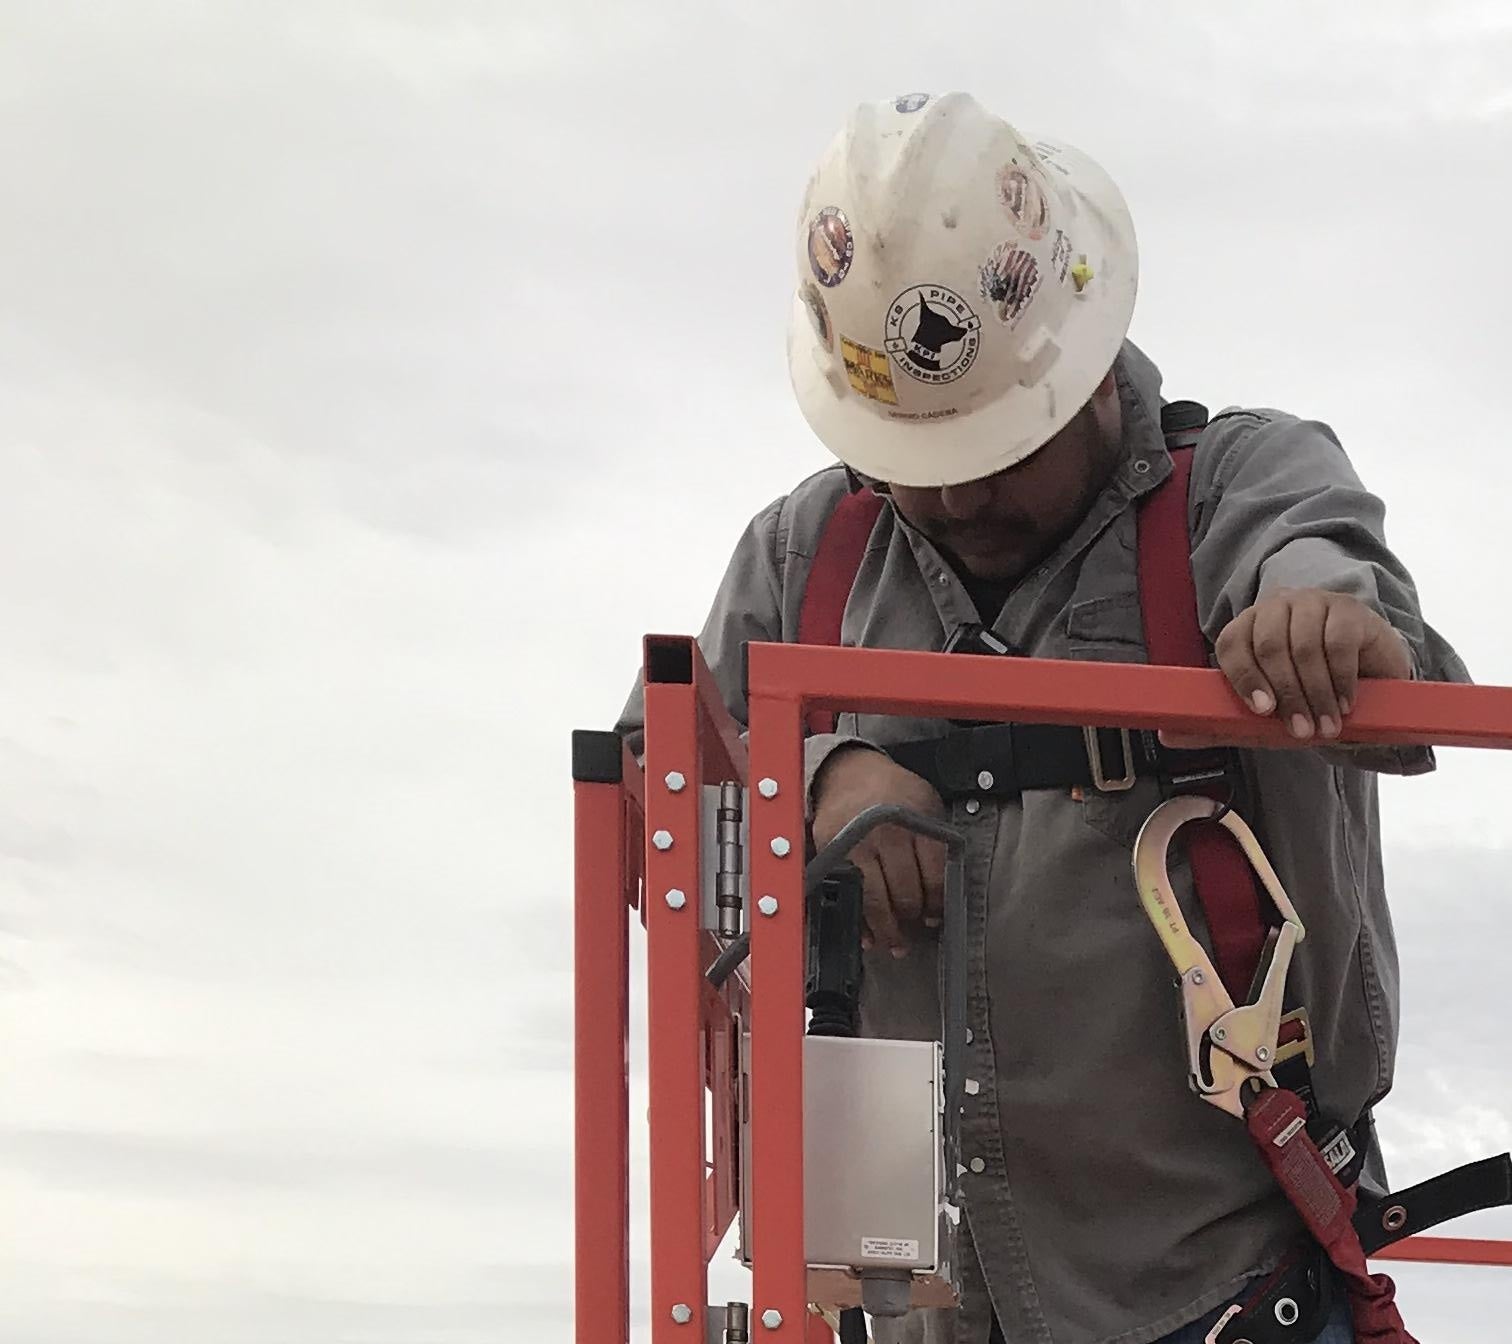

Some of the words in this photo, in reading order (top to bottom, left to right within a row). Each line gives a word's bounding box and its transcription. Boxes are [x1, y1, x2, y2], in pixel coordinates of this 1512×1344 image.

[930, 290, 965, 314] PIPE
[900, 338, 976, 381] INSPECTIONS
[914, 344, 935, 359] KPI
